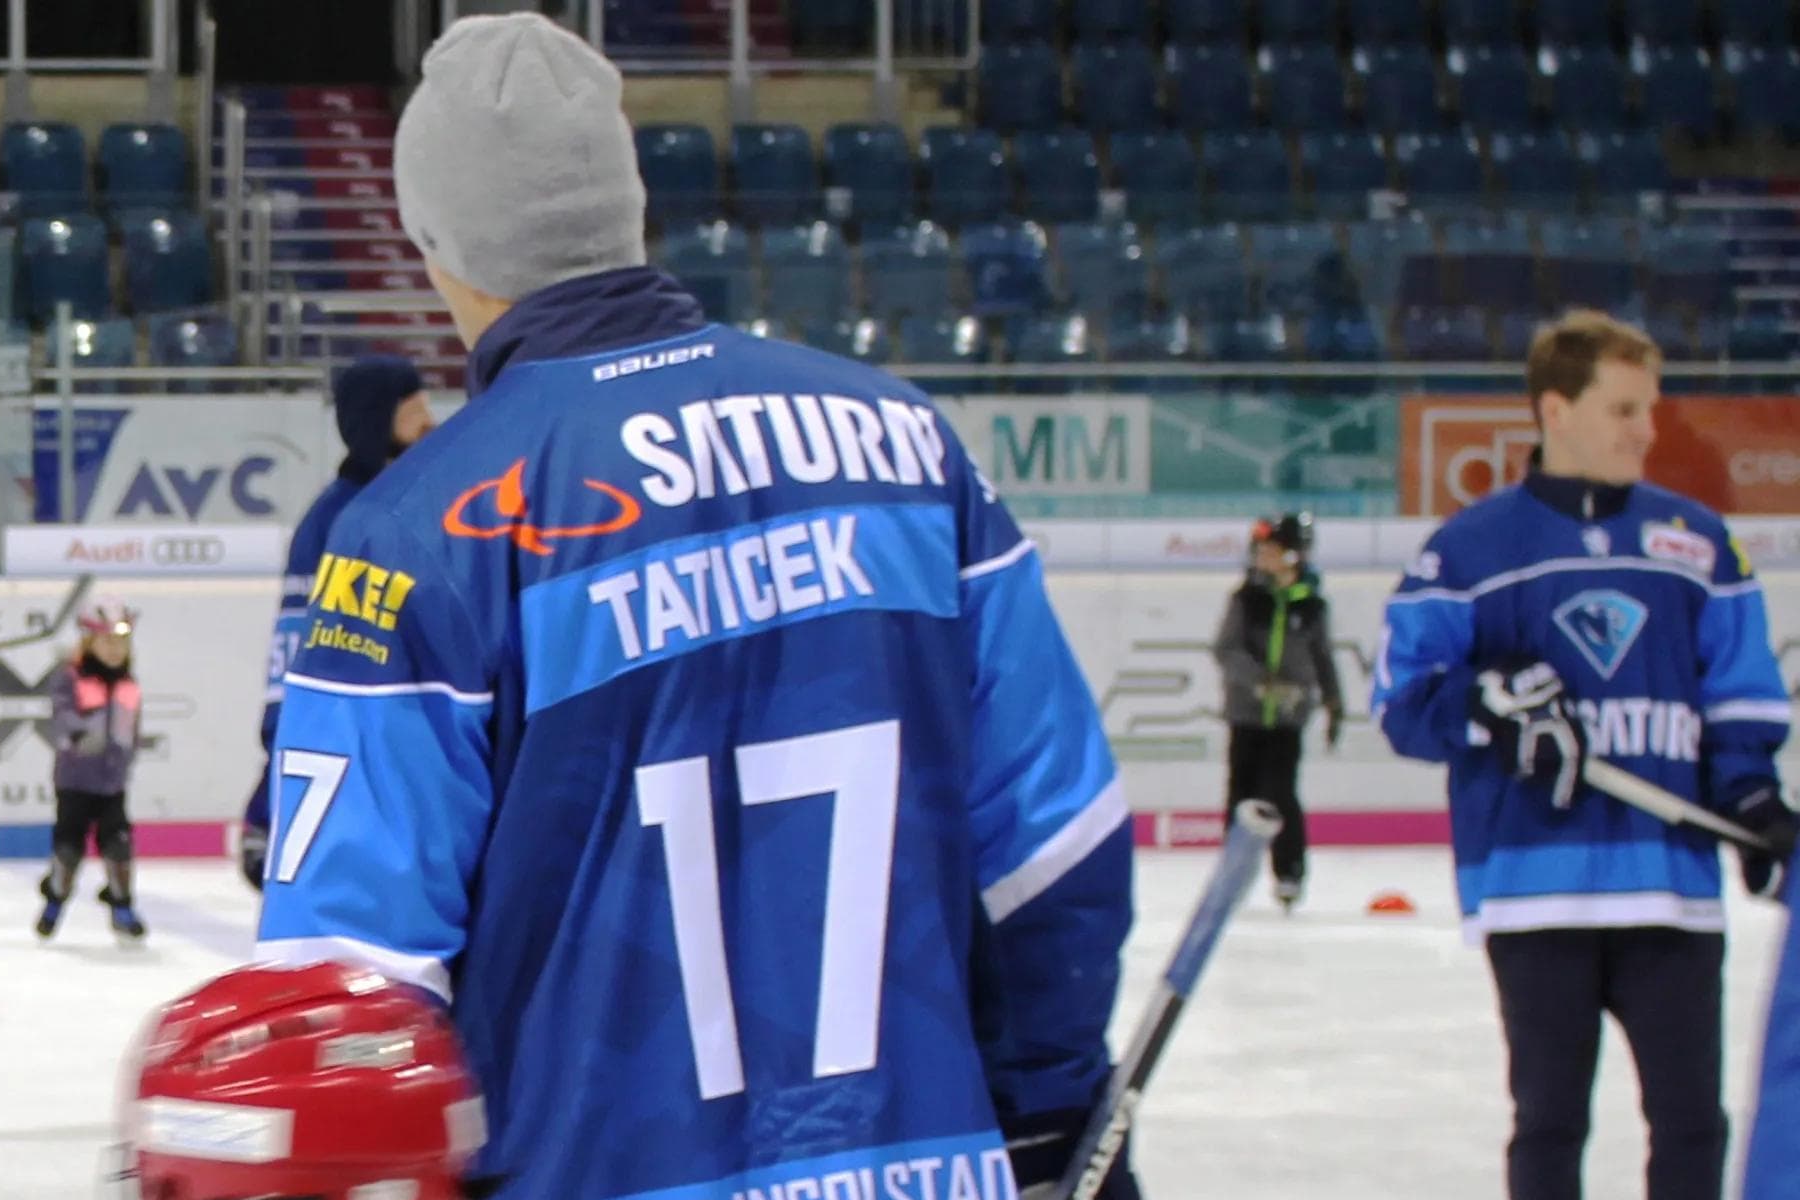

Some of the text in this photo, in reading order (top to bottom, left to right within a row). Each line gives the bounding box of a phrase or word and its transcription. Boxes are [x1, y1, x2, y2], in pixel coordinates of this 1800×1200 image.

[593, 344, 715, 382] BAUER
[620, 394, 946, 507] SATURN
[66, 538, 145, 562] Audi
[588, 515, 874, 660] TATICEK
[634, 719, 900, 1101] 17
